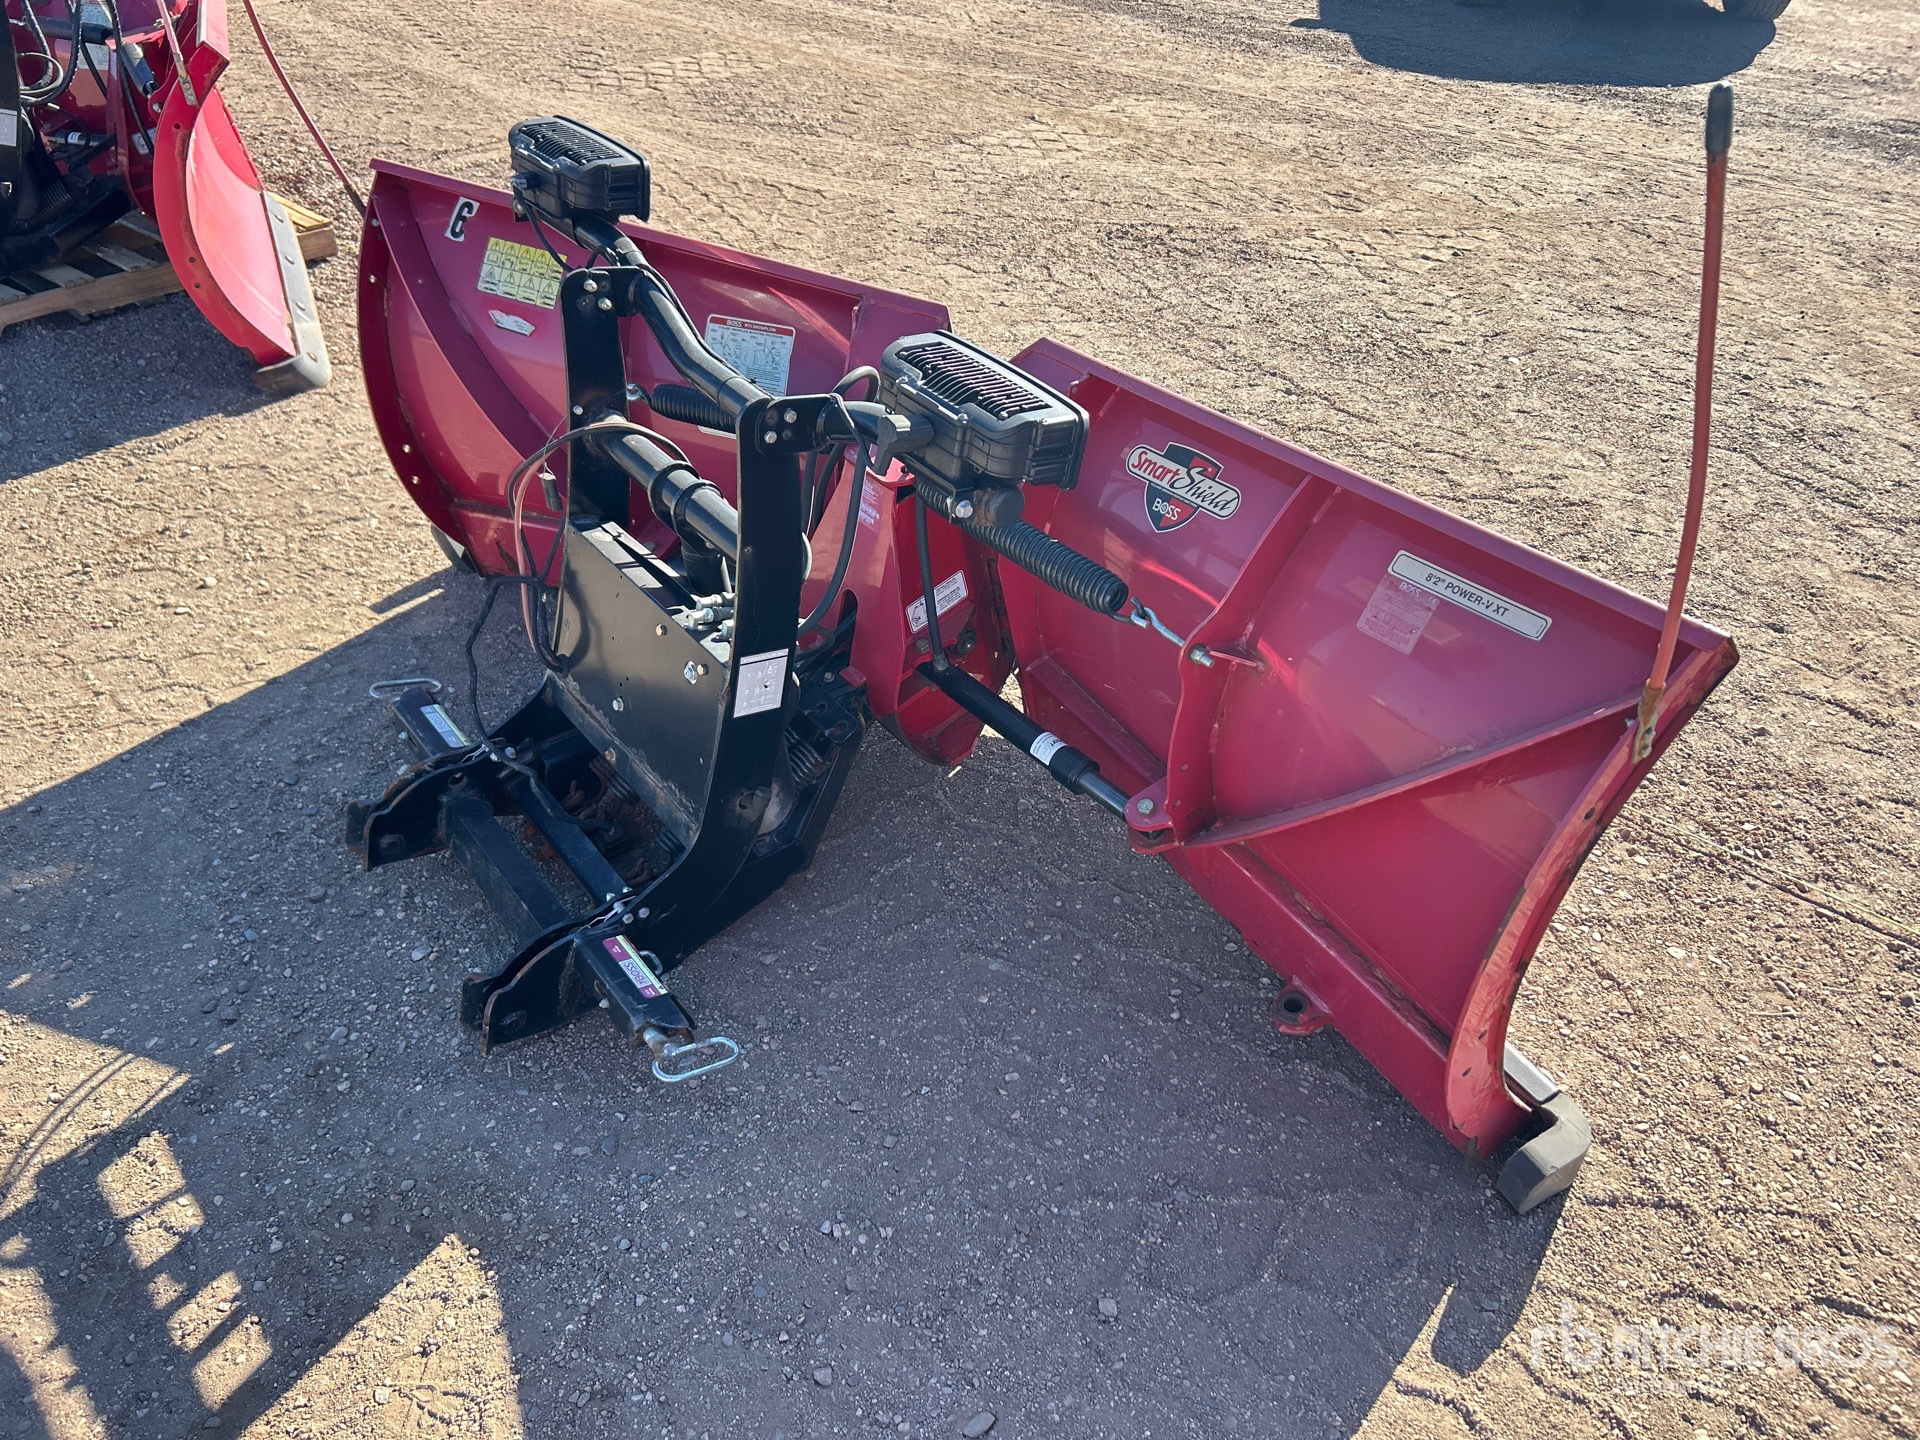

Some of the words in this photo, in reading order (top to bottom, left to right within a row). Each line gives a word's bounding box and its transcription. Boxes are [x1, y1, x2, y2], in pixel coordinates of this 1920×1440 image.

[726, 319, 743, 328] BOSS
[1152, 497, 1182, 521] BOSS
[1398, 581, 1423, 598] BOSS
[1444, 577, 1495, 610] POWER-V
[1491, 603, 1511, 618] XT
